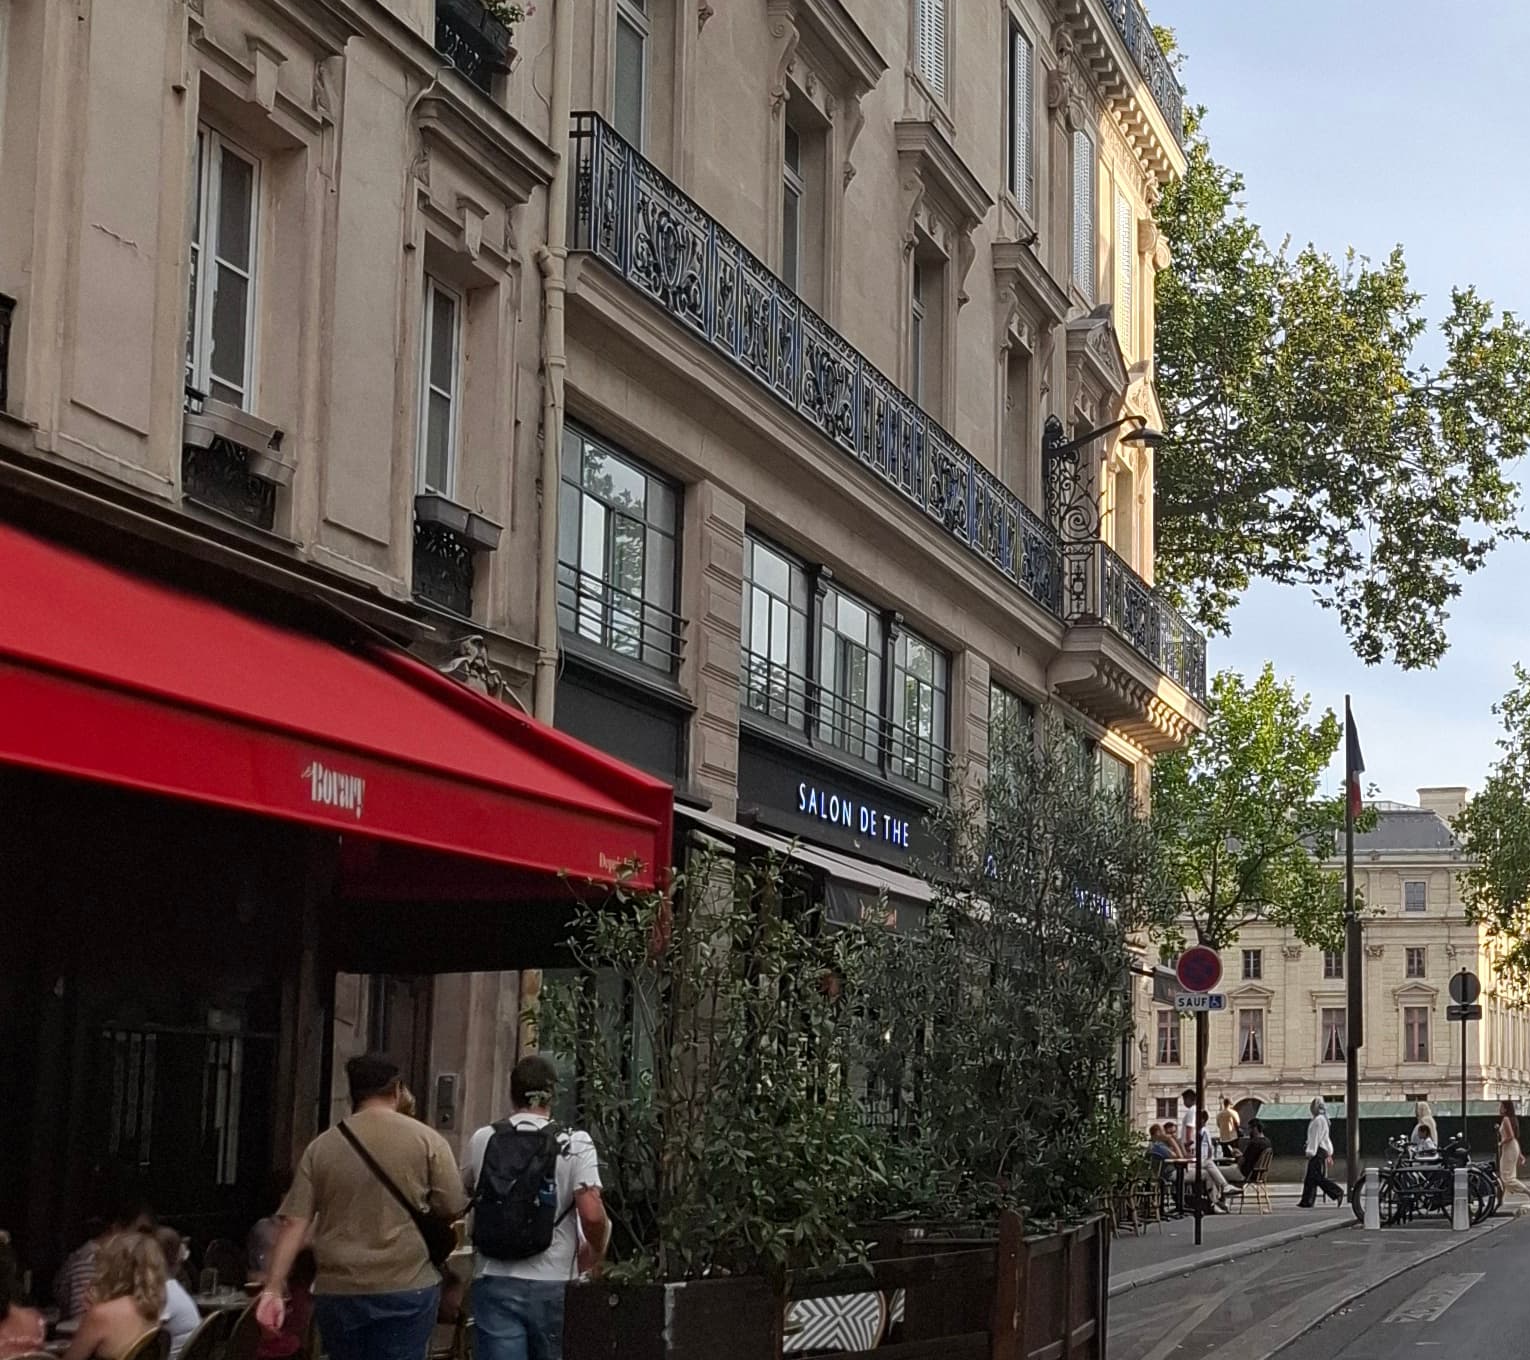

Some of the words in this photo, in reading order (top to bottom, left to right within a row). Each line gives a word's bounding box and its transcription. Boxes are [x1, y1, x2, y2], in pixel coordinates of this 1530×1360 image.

[800, 782, 851, 827] SALON
[860, 806, 876, 835] DE
[883, 815, 908, 847] THE
[599, 851, 622, 873] Depu
[1178, 997, 1208, 1007] SAUF
